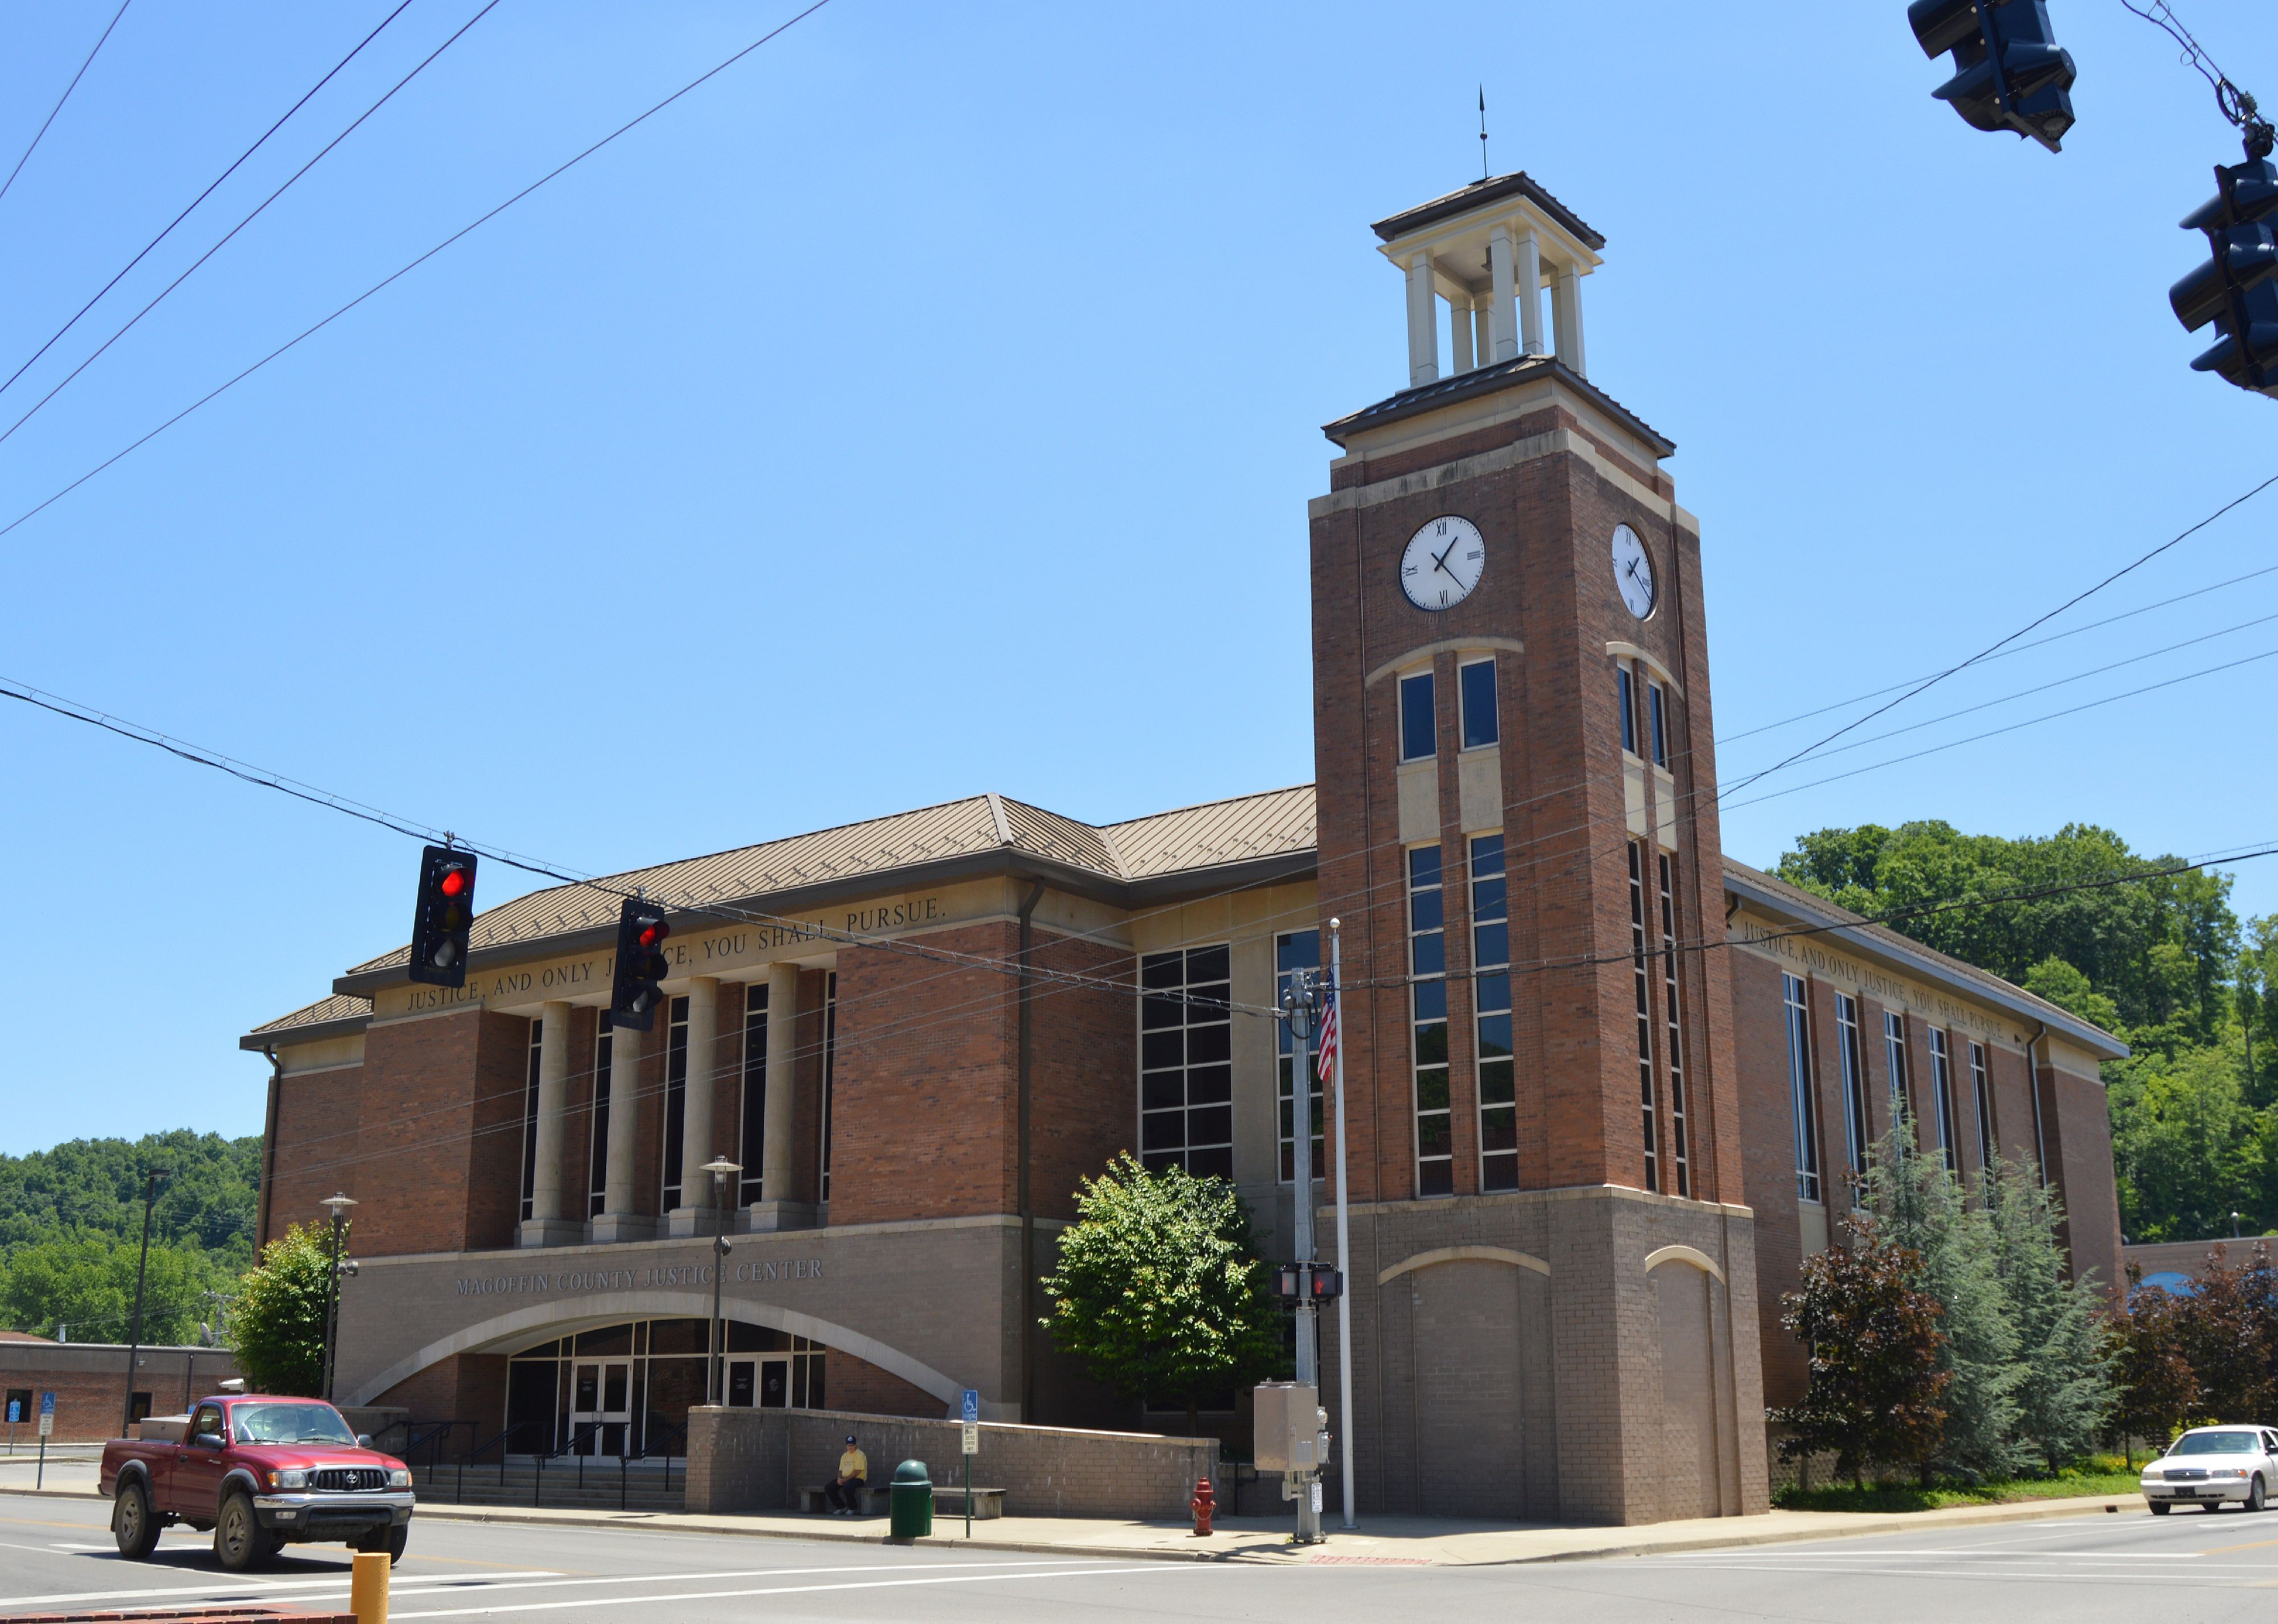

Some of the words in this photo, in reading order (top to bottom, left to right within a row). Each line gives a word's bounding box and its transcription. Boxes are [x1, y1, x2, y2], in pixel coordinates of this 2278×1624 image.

[1436, 521, 1447, 537] XII
[1467, 550, 1481, 561] III
[1405, 565, 1418, 577] IX
[1439, 589, 1448, 605] VI
[494, 973, 532, 995] AND
[542, 962, 593, 988] ONLY
[704, 934, 746, 959] YOU
[759, 920, 830, 950] SHALL
[847, 898, 945, 933] PURSUE.
[1802, 945, 1825, 970] AND
[1830, 956, 1857, 983] ONLY
[1865, 970, 1908, 1004] JUSTICE,
[1913, 989, 1933, 1013] YOU
[1938, 998, 1967, 1025] SHALL
[457, 1275, 550, 1295] MAGOFFIN
[557, 1270, 638, 1291] COUNTY
[644, 1265, 727, 1287] JUSTICE
[737, 1259, 822, 1282] CENTER
